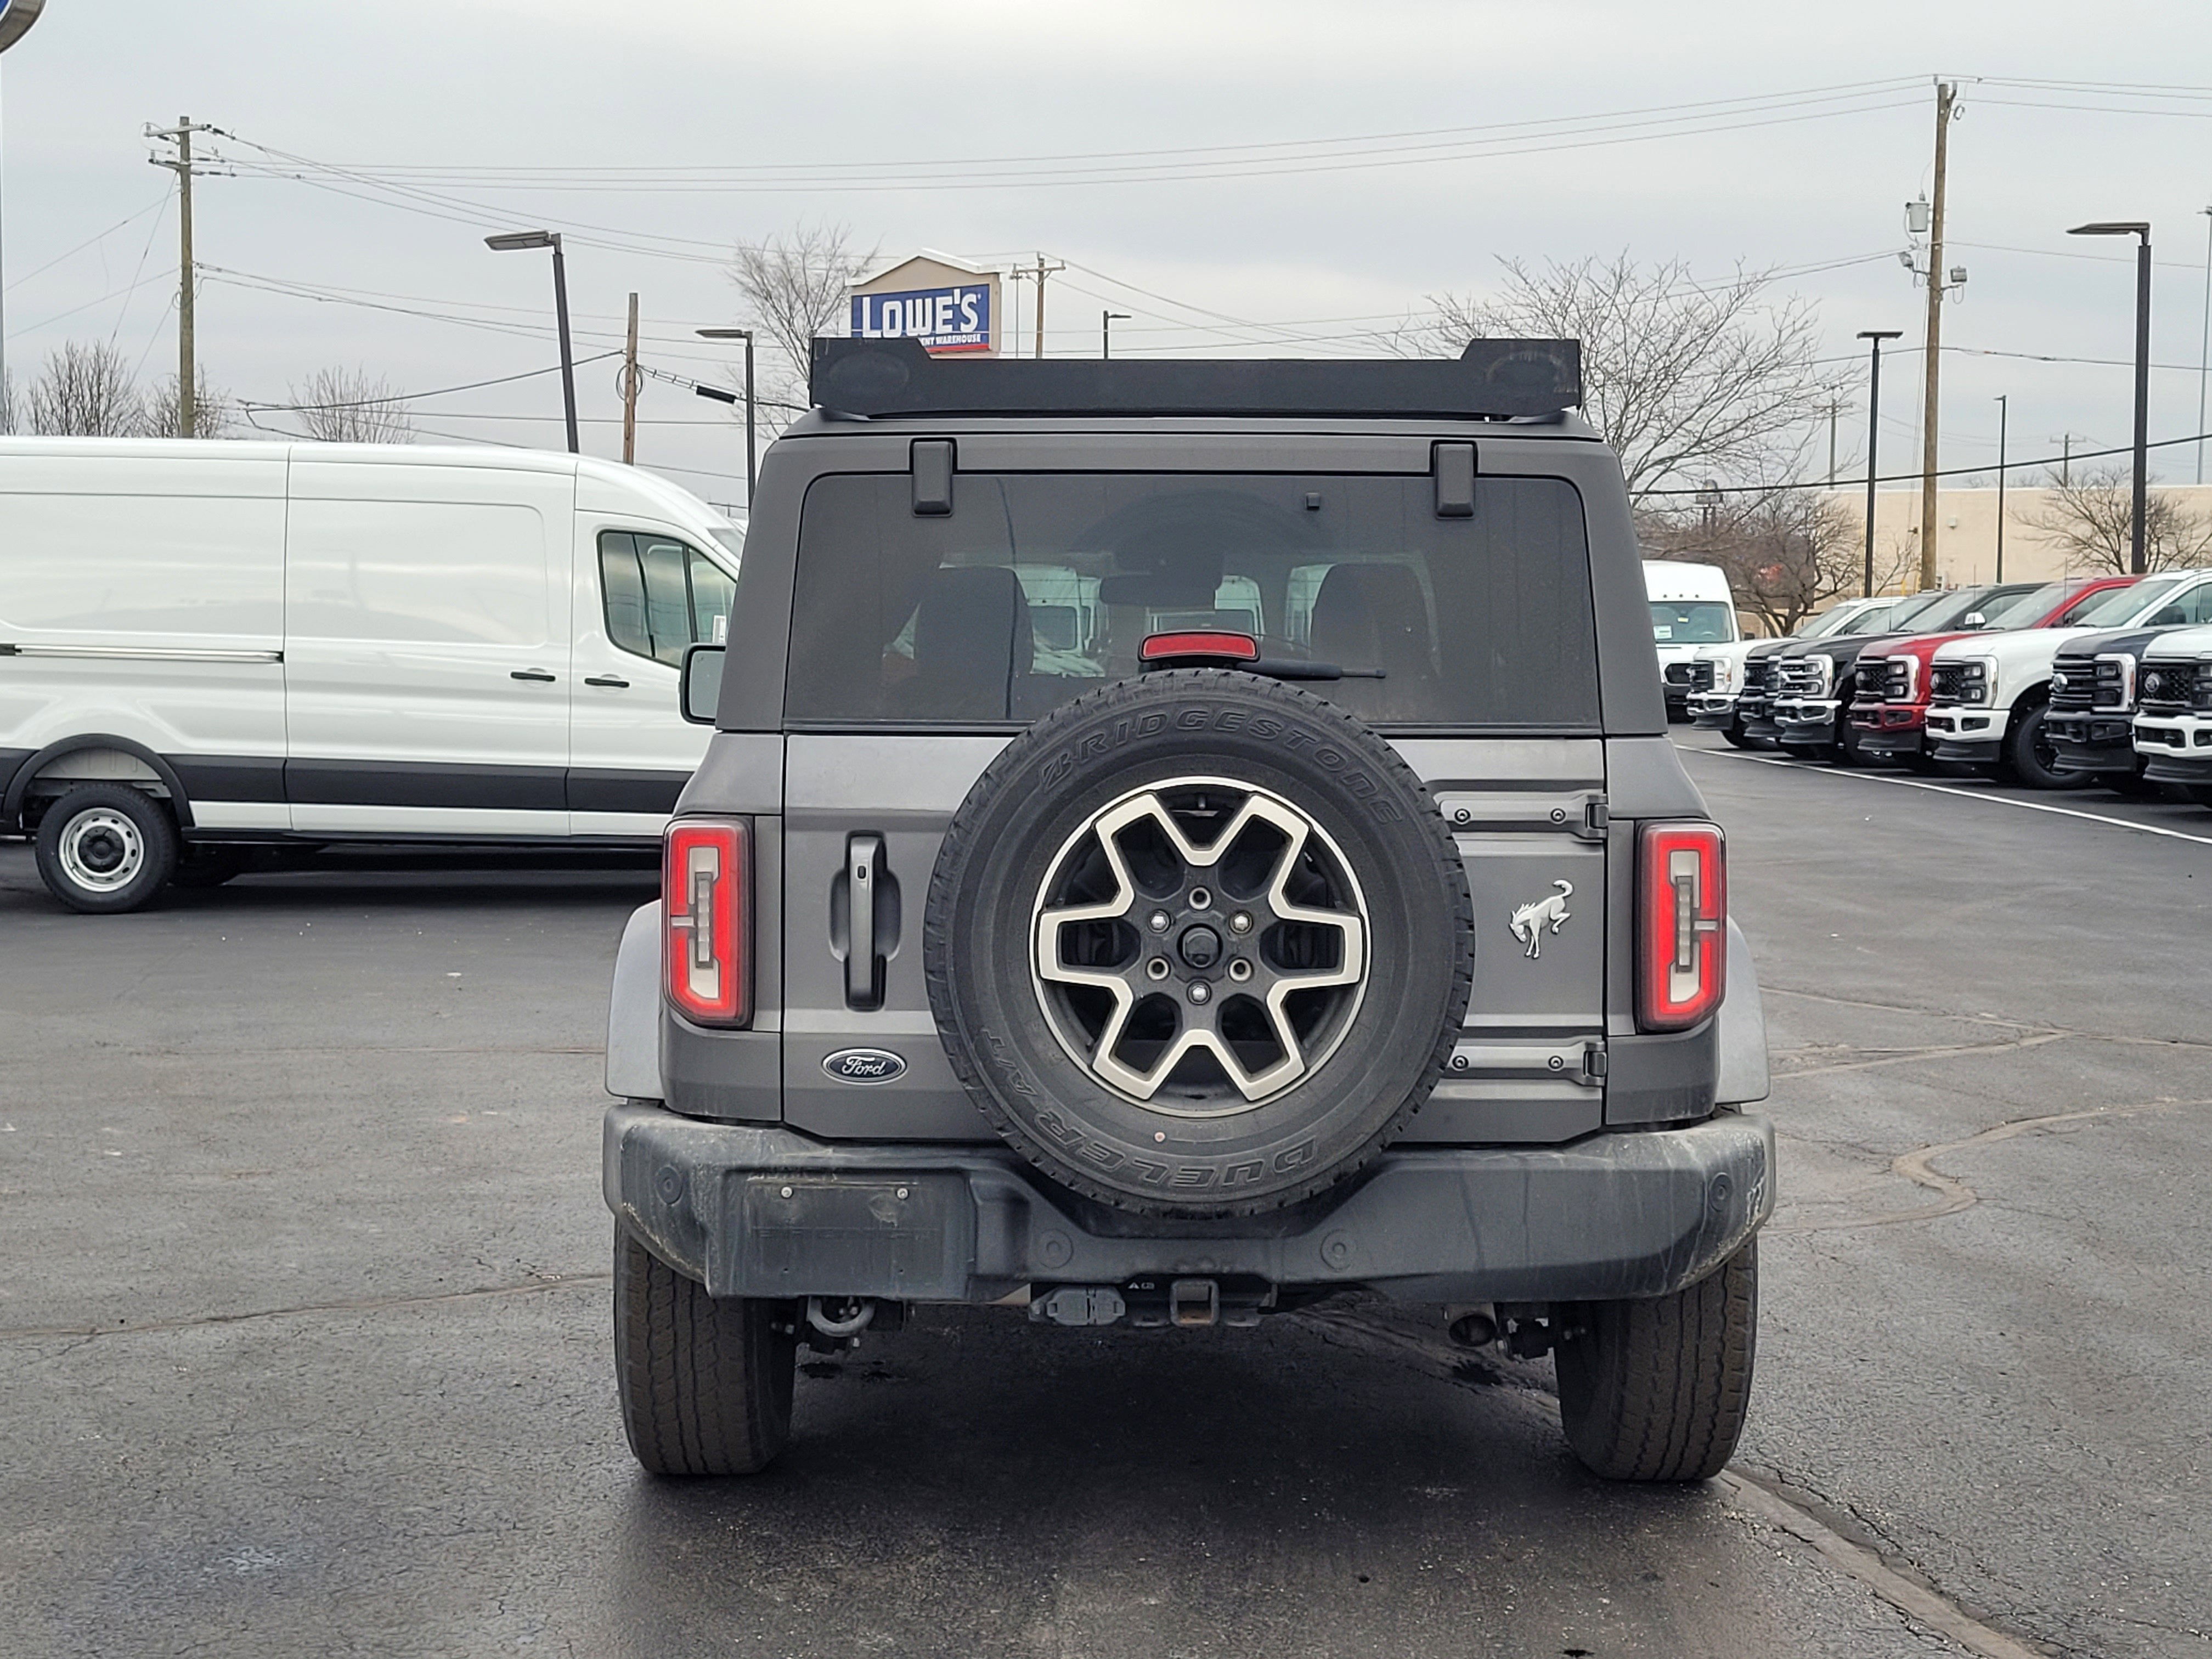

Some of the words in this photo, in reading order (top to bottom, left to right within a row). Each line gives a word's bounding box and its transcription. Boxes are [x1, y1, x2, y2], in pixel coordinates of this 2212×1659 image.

[862, 289, 979, 337] LOWE'S
[935, 334, 981, 345] WAREHOUSE
[1042, 709, 1402, 823] BRIDGESTONE
[842, 1056, 887, 1075] Ford
[1034, 1107, 1317, 1188] DUELER
